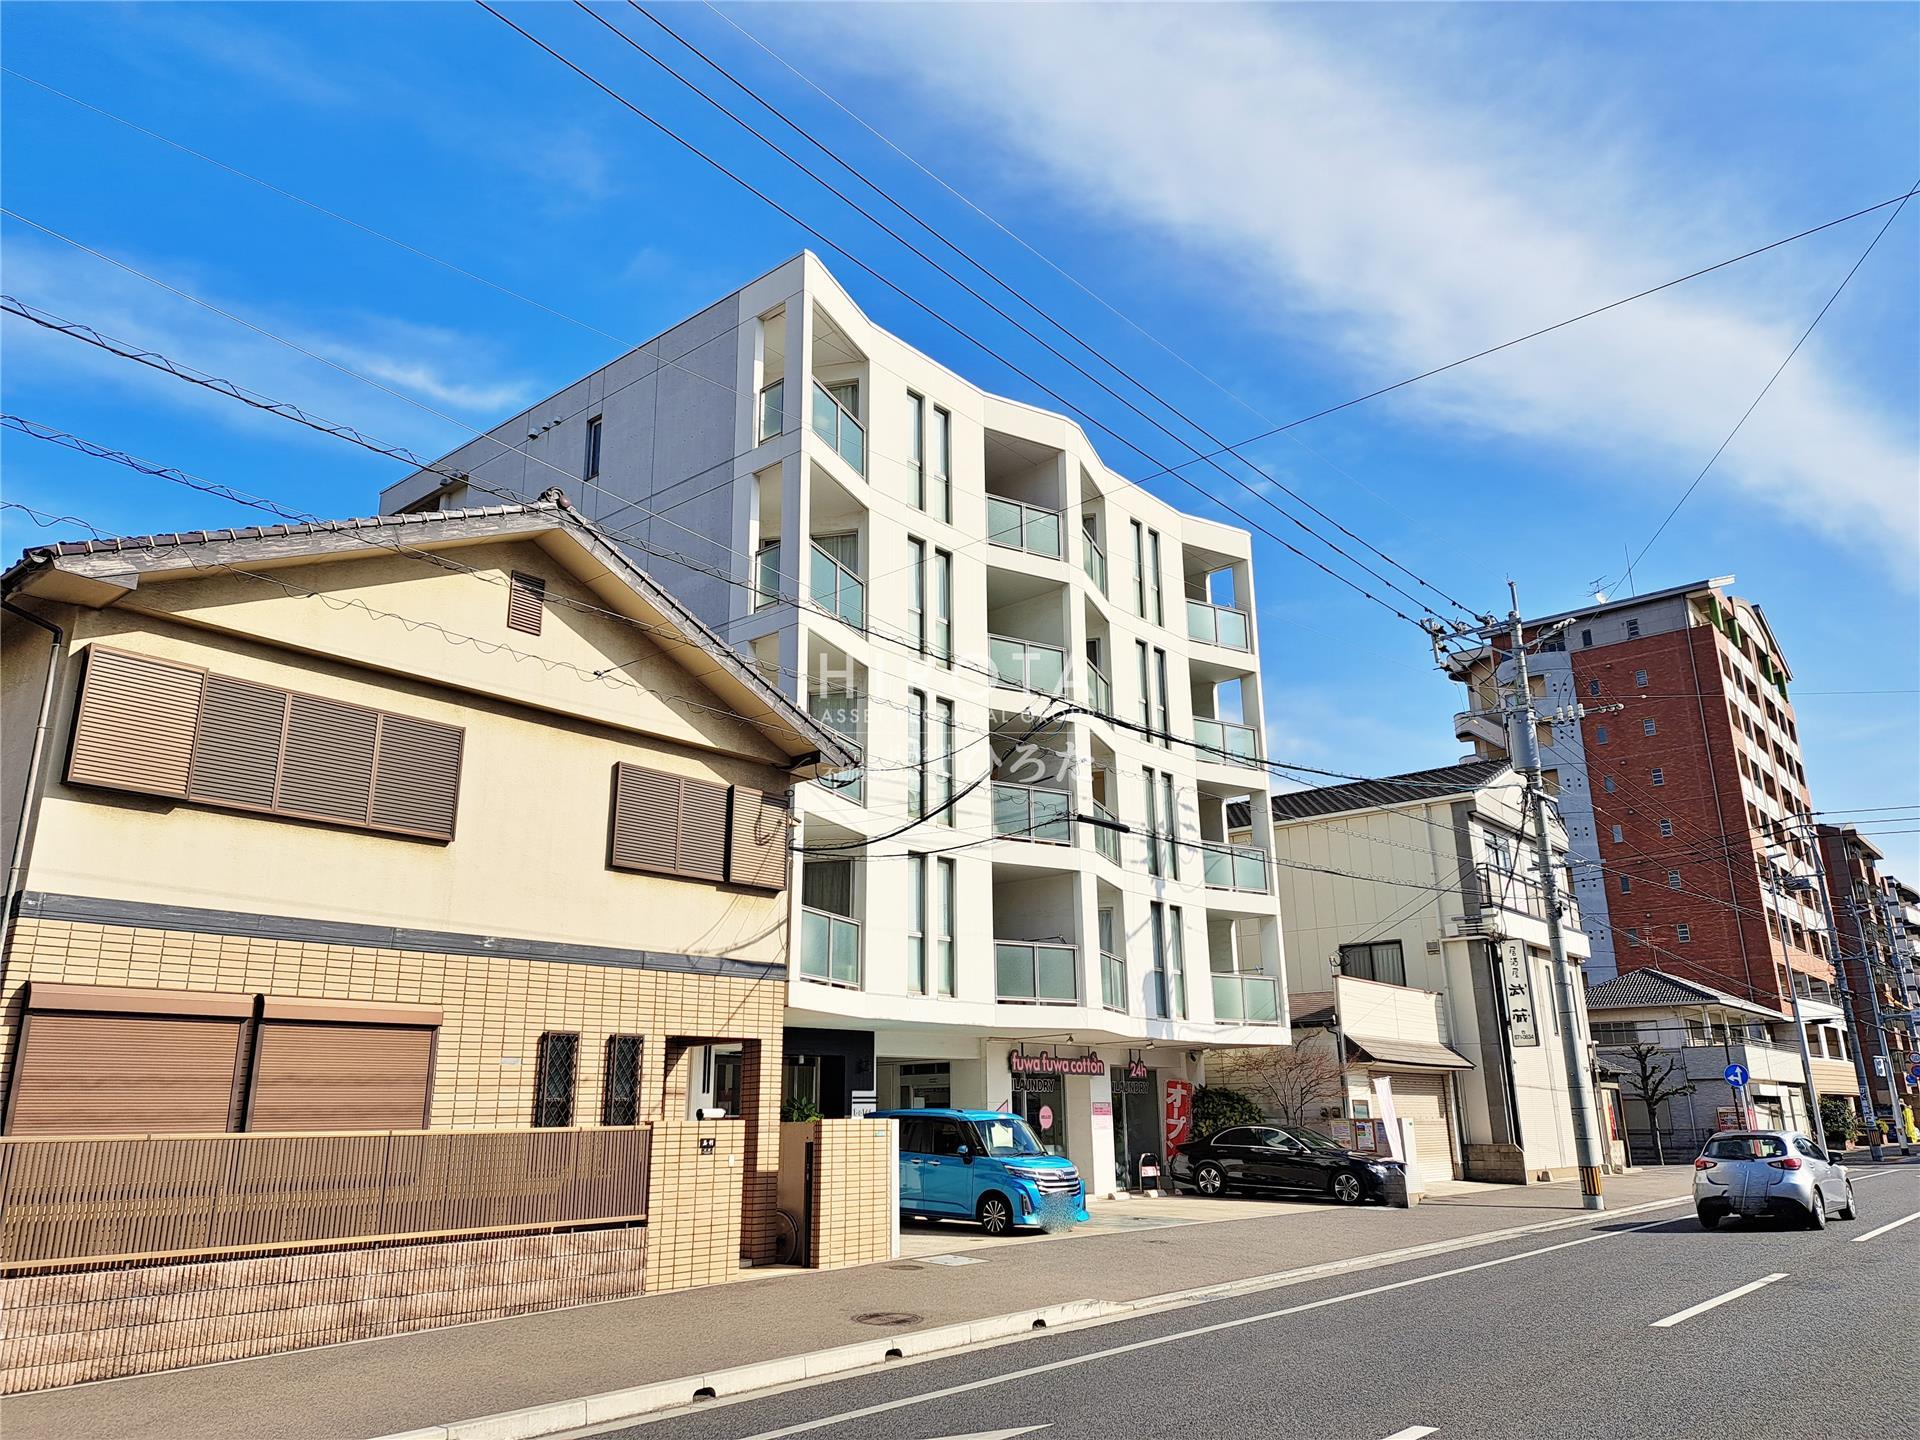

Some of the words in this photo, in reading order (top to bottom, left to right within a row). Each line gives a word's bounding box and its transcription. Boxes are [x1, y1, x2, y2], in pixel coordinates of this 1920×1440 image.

[1012, 1051, 1040, 1071] fuwa
[1042, 1053, 1069, 1072] fuwa
[1070, 1056, 1104, 1074] cotton
[1130, 1061, 1147, 1077] 24h
